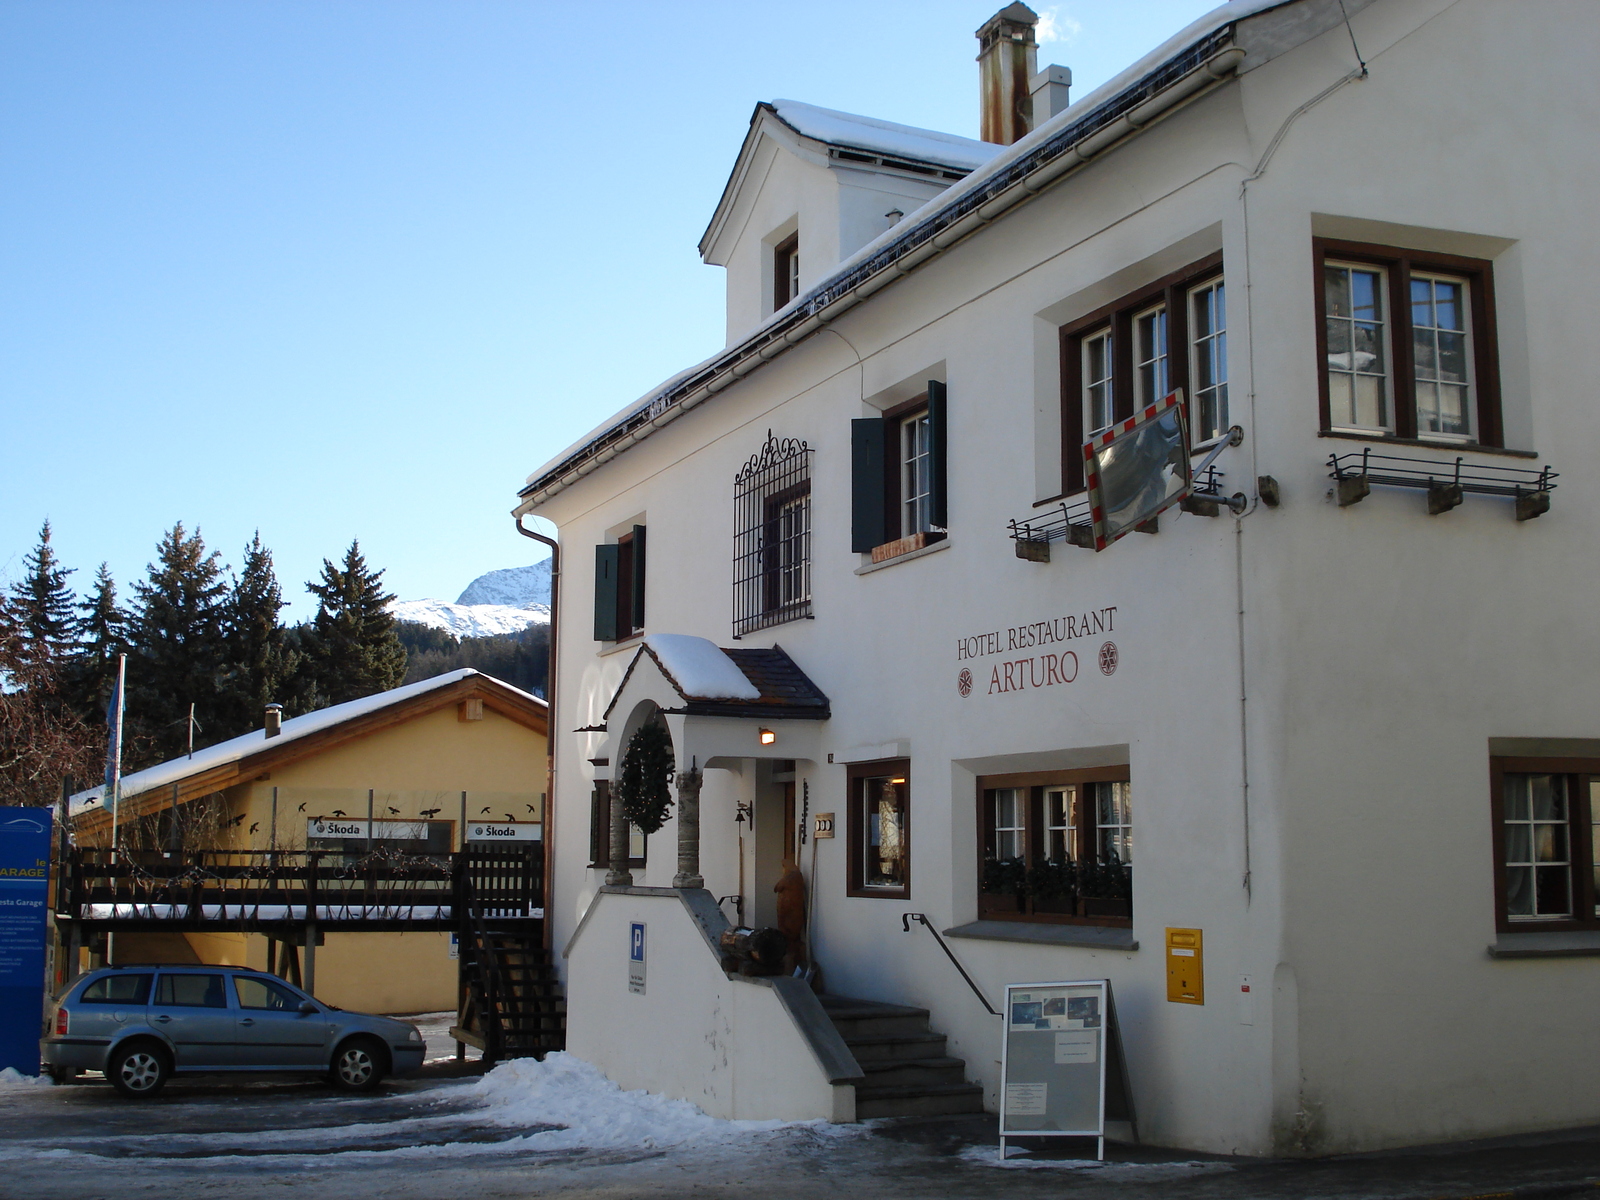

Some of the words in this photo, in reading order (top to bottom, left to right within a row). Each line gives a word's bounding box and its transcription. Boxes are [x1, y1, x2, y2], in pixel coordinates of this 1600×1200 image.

[958, 631, 1003, 660] HOTEL
[1008, 607, 1118, 651] RESTAURANT
[988, 651, 1078, 694] ARTURO
[327, 822, 360, 834] Škoda
[486, 824, 515, 837] Škoda
[16, 899, 43, 908] Garage
[634, 928, 642, 956] P
